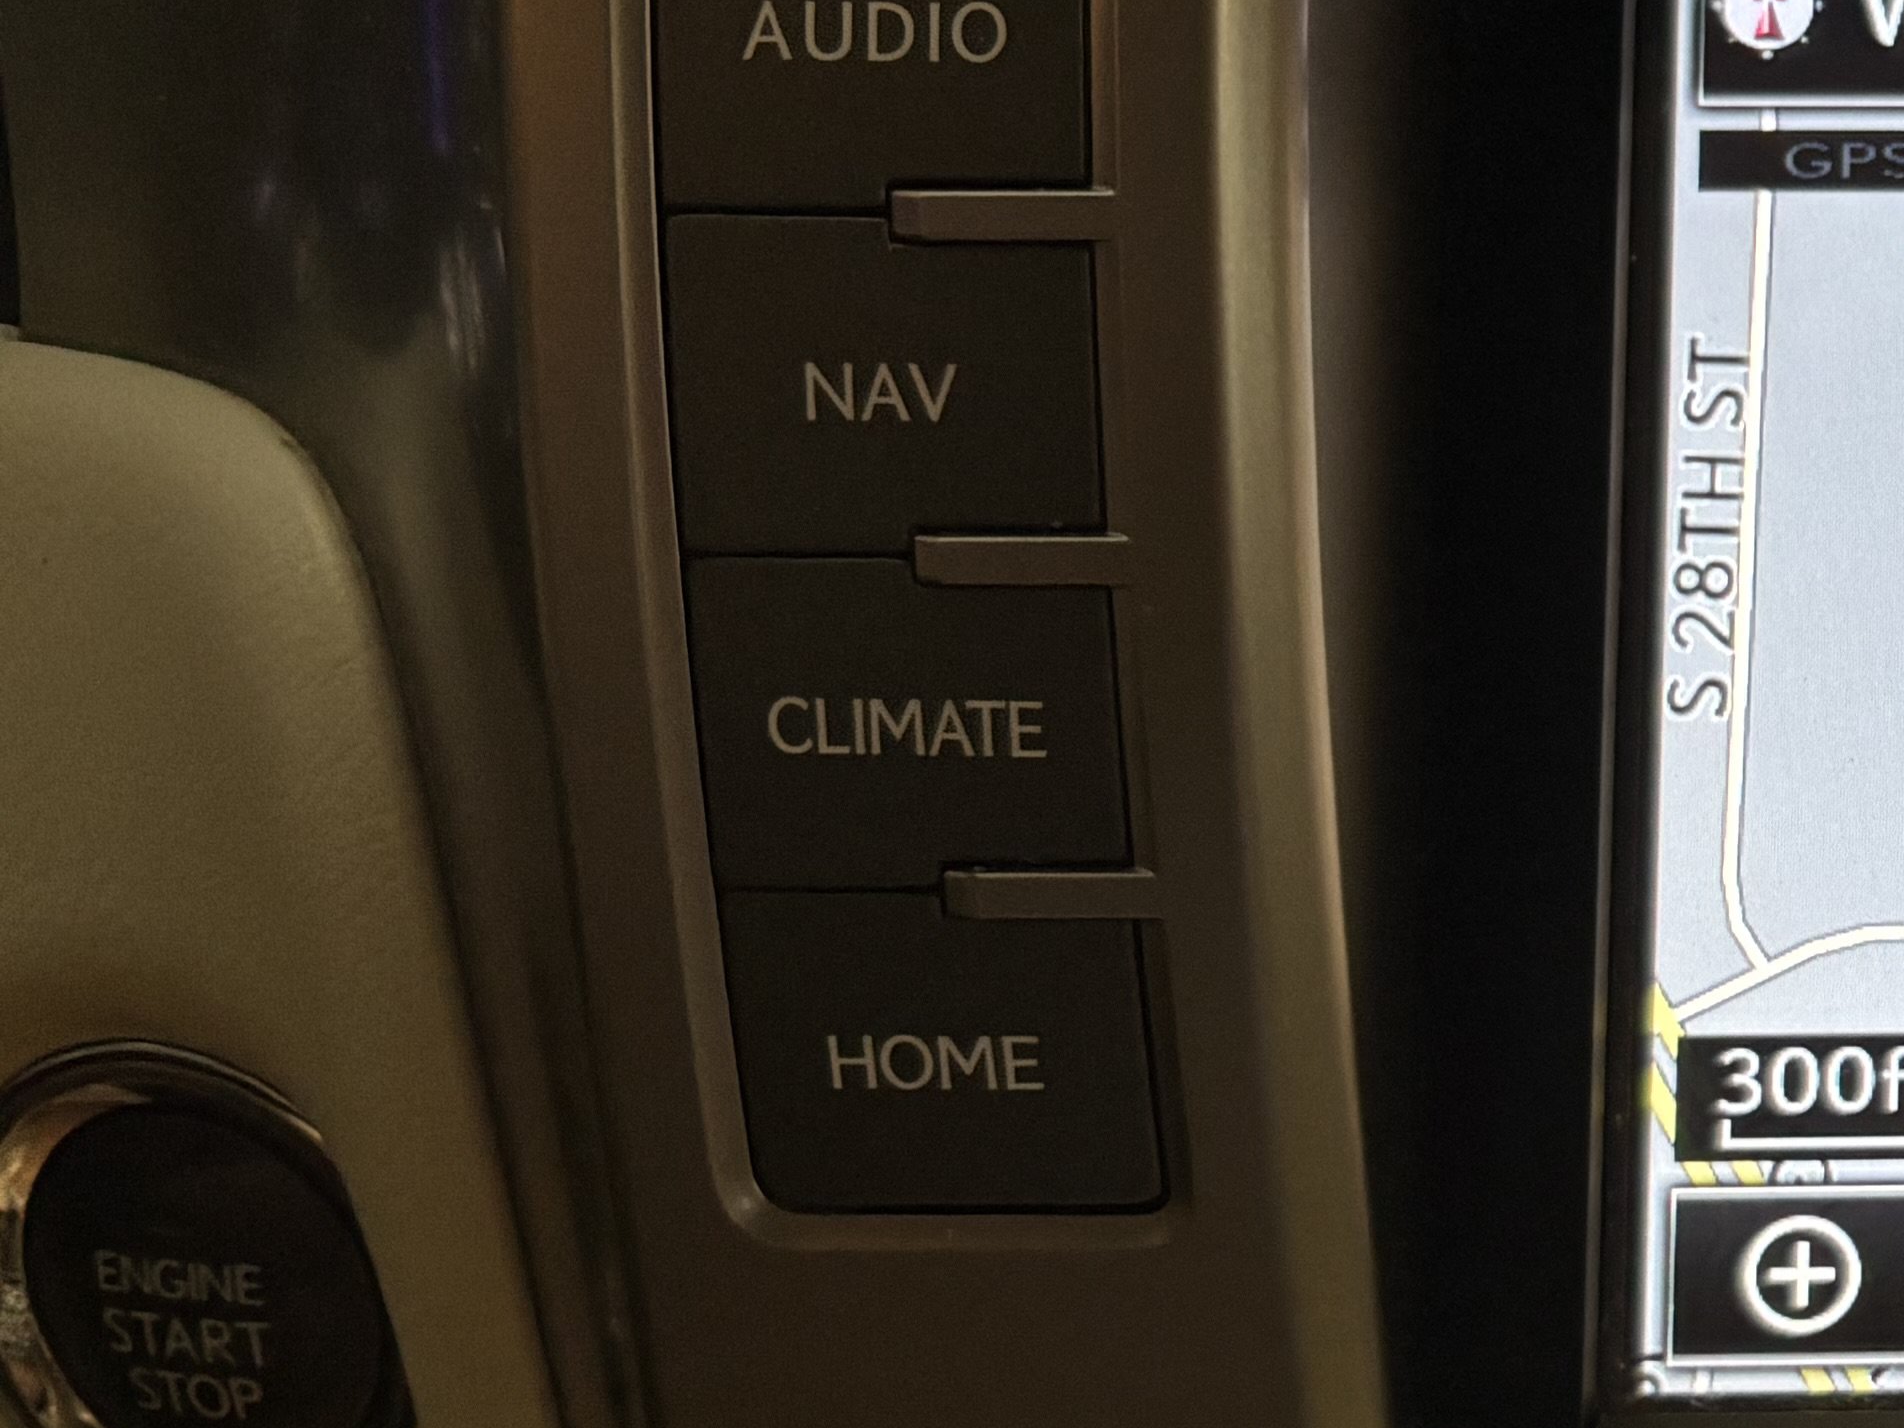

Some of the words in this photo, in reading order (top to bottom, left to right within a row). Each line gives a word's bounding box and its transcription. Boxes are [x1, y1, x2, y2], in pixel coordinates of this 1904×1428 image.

[742, 0, 1007, 64] AUDIO
[803, 362, 957, 423] NAV
[1683, 335, 1750, 427] ST
[1671, 454, 1745, 652] 28TH
[768, 695, 1047, 759] CLIMATE
[1666, 678, 1728, 718] S
[827, 1033, 1045, 1092] HOME
[94, 1249, 267, 1307] ENGINE
[103, 1308, 271, 1368] START
[130, 1367, 264, 1420] STOP
